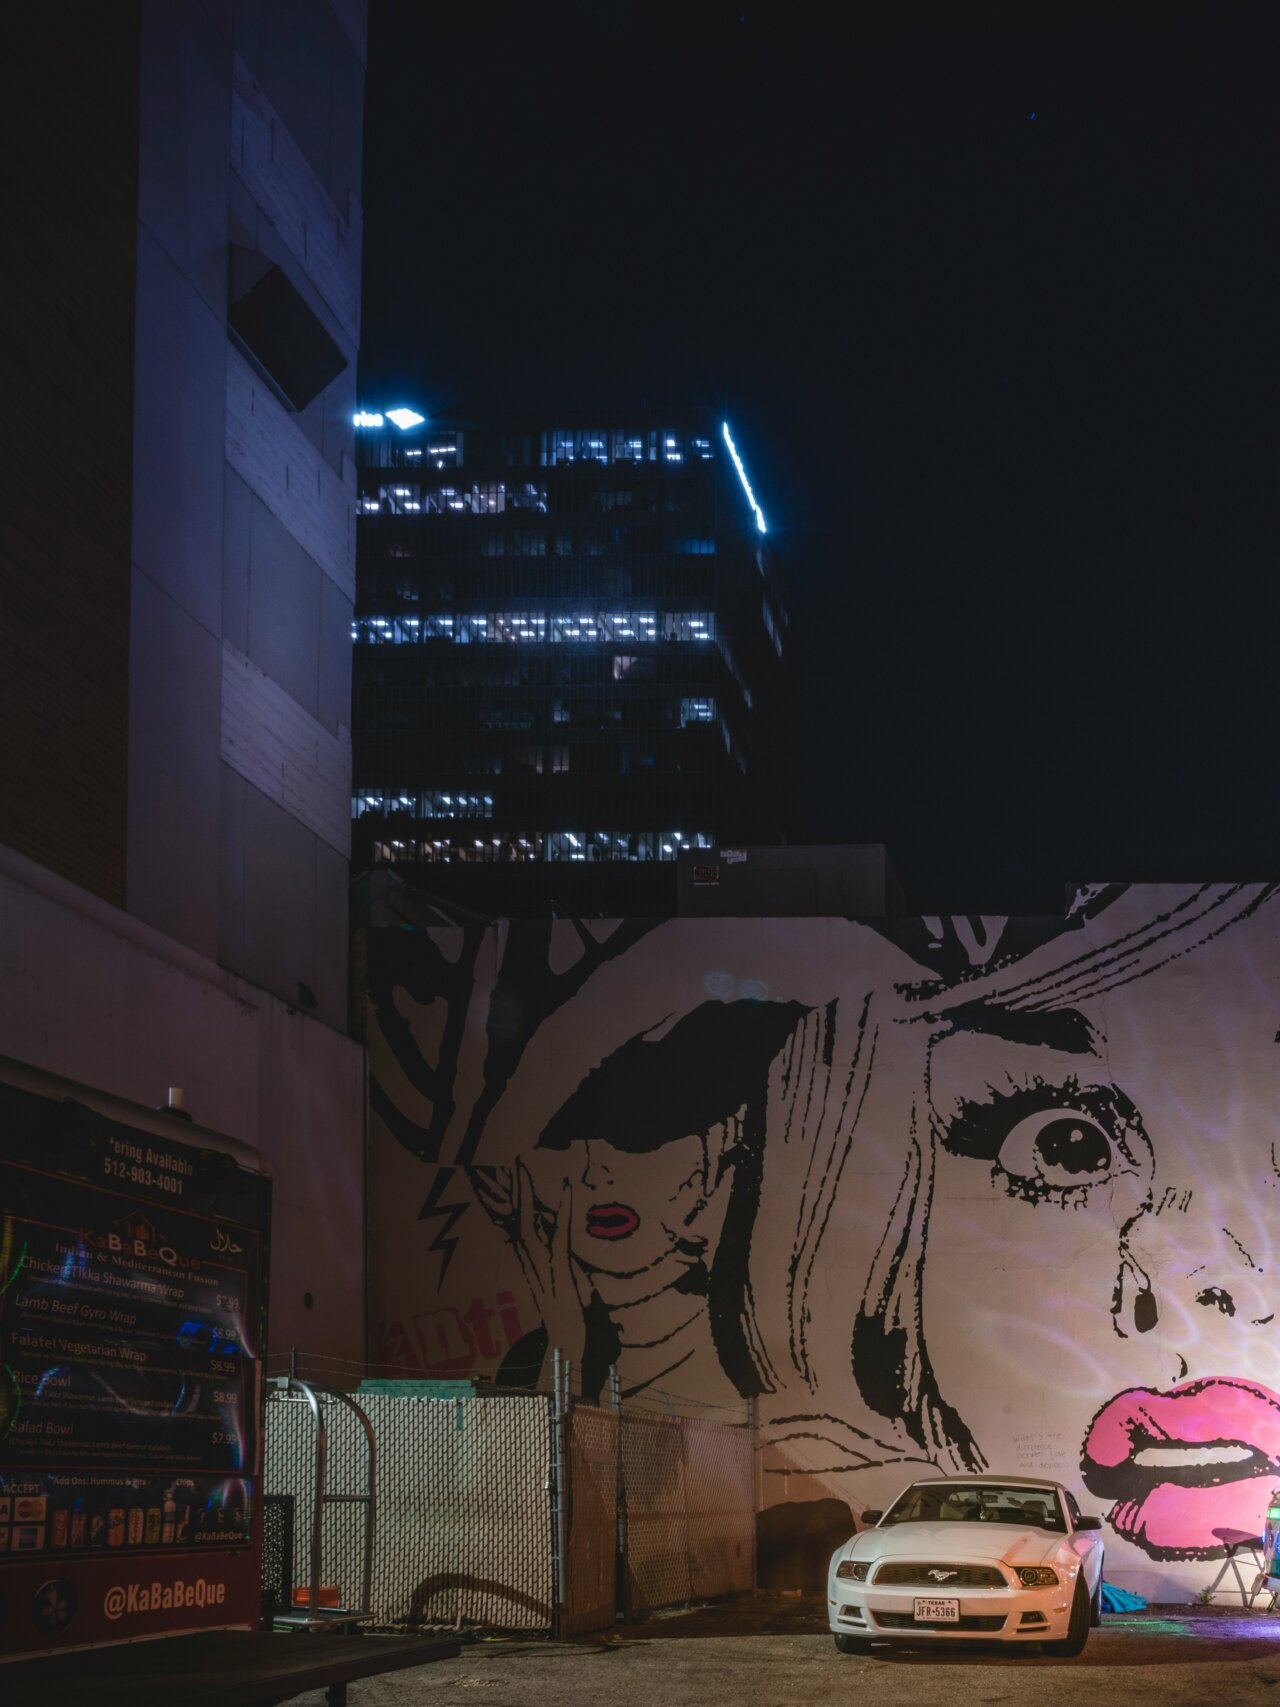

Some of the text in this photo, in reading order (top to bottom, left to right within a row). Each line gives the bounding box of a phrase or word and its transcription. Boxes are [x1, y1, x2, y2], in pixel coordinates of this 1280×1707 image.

[104, 1156, 183, 1195] 512-903-4001
[146, 1147, 193, 1176] Available
[103, 1271, 157, 1293] Shawarma
[158, 1280, 184, 1299] Wrap
[112, 1255, 185, 1279] Mediterranean
[187, 1271, 219, 1287] Fusion
[15, 1294, 48, 1311] Lamb
[52, 1300, 77, 1315] Beef
[80, 1304, 106, 1323] Gyro
[109, 1310, 137, 1326] Wrap
[11, 1331, 147, 1363] Falafel Vegetarian Wrap
[46, 1421, 73, 1435] Bowl
[3, 1483, 40, 1495] ACCEPT
[90, 1477, 123, 1487] Hummus
[104, 1578, 225, 1620] @KaBaBeQue
